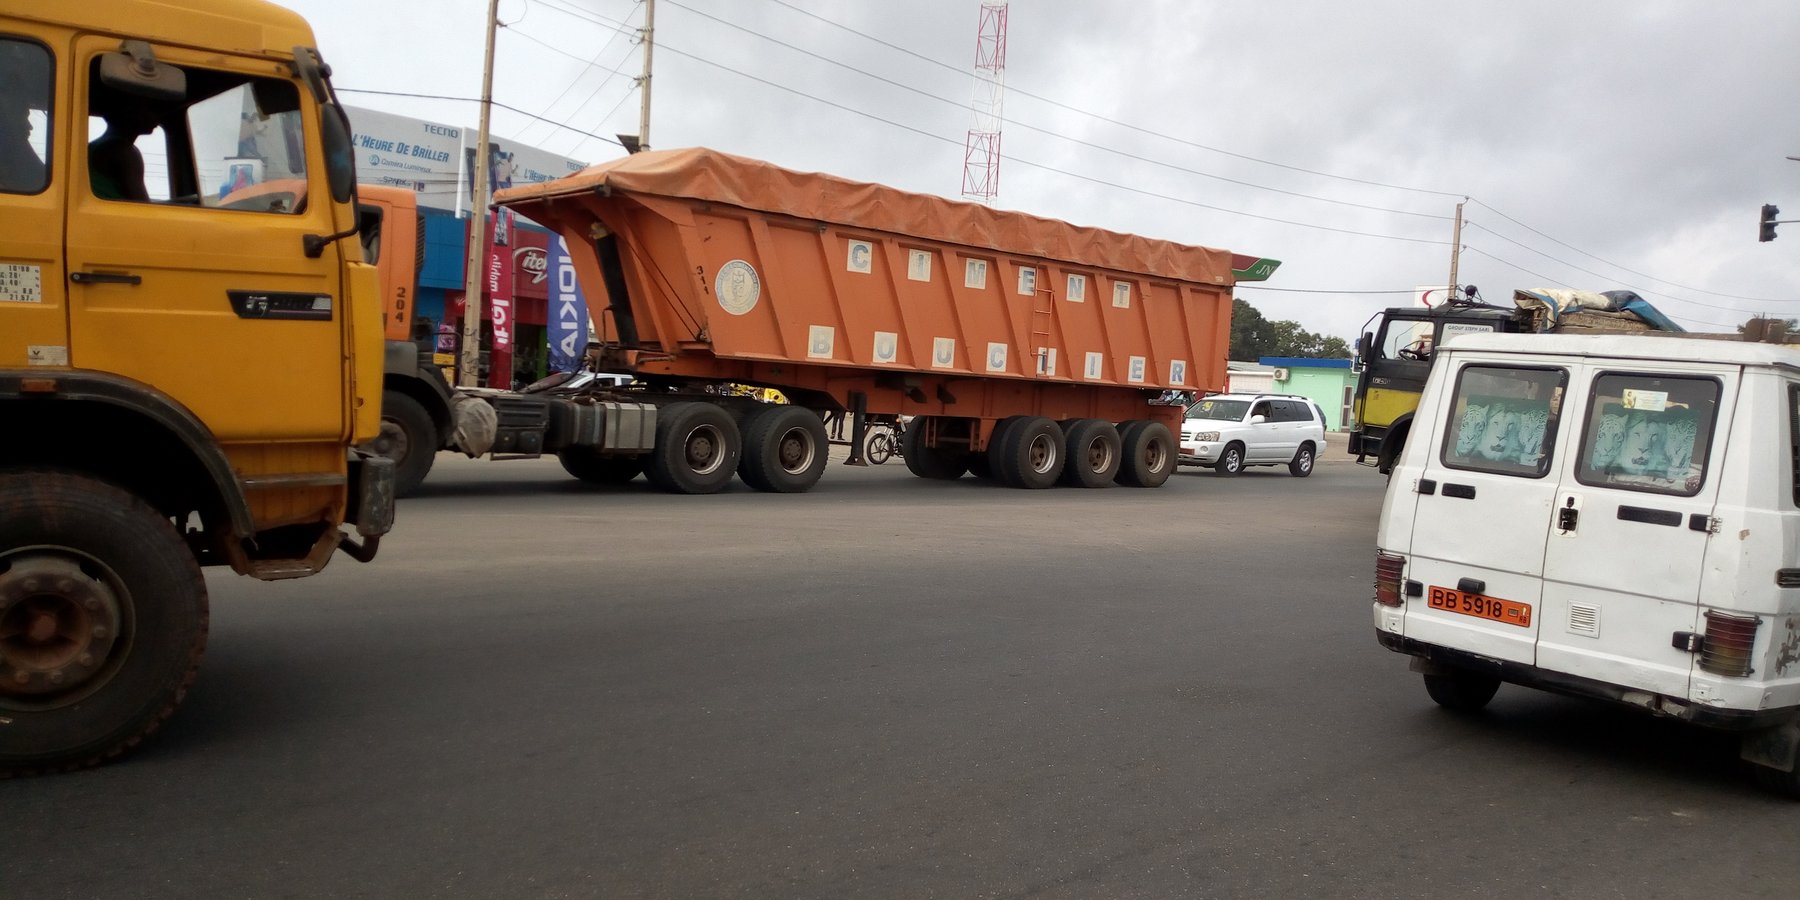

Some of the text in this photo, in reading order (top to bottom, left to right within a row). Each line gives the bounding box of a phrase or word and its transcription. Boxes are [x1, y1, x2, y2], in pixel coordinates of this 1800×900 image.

[424, 124, 459, 139] TECNO
[521, 252, 547, 271] itel
[395, 286, 406, 323] 204
[1433, 589, 1457, 608] BB
[1463, 595, 1503, 618] 5918
